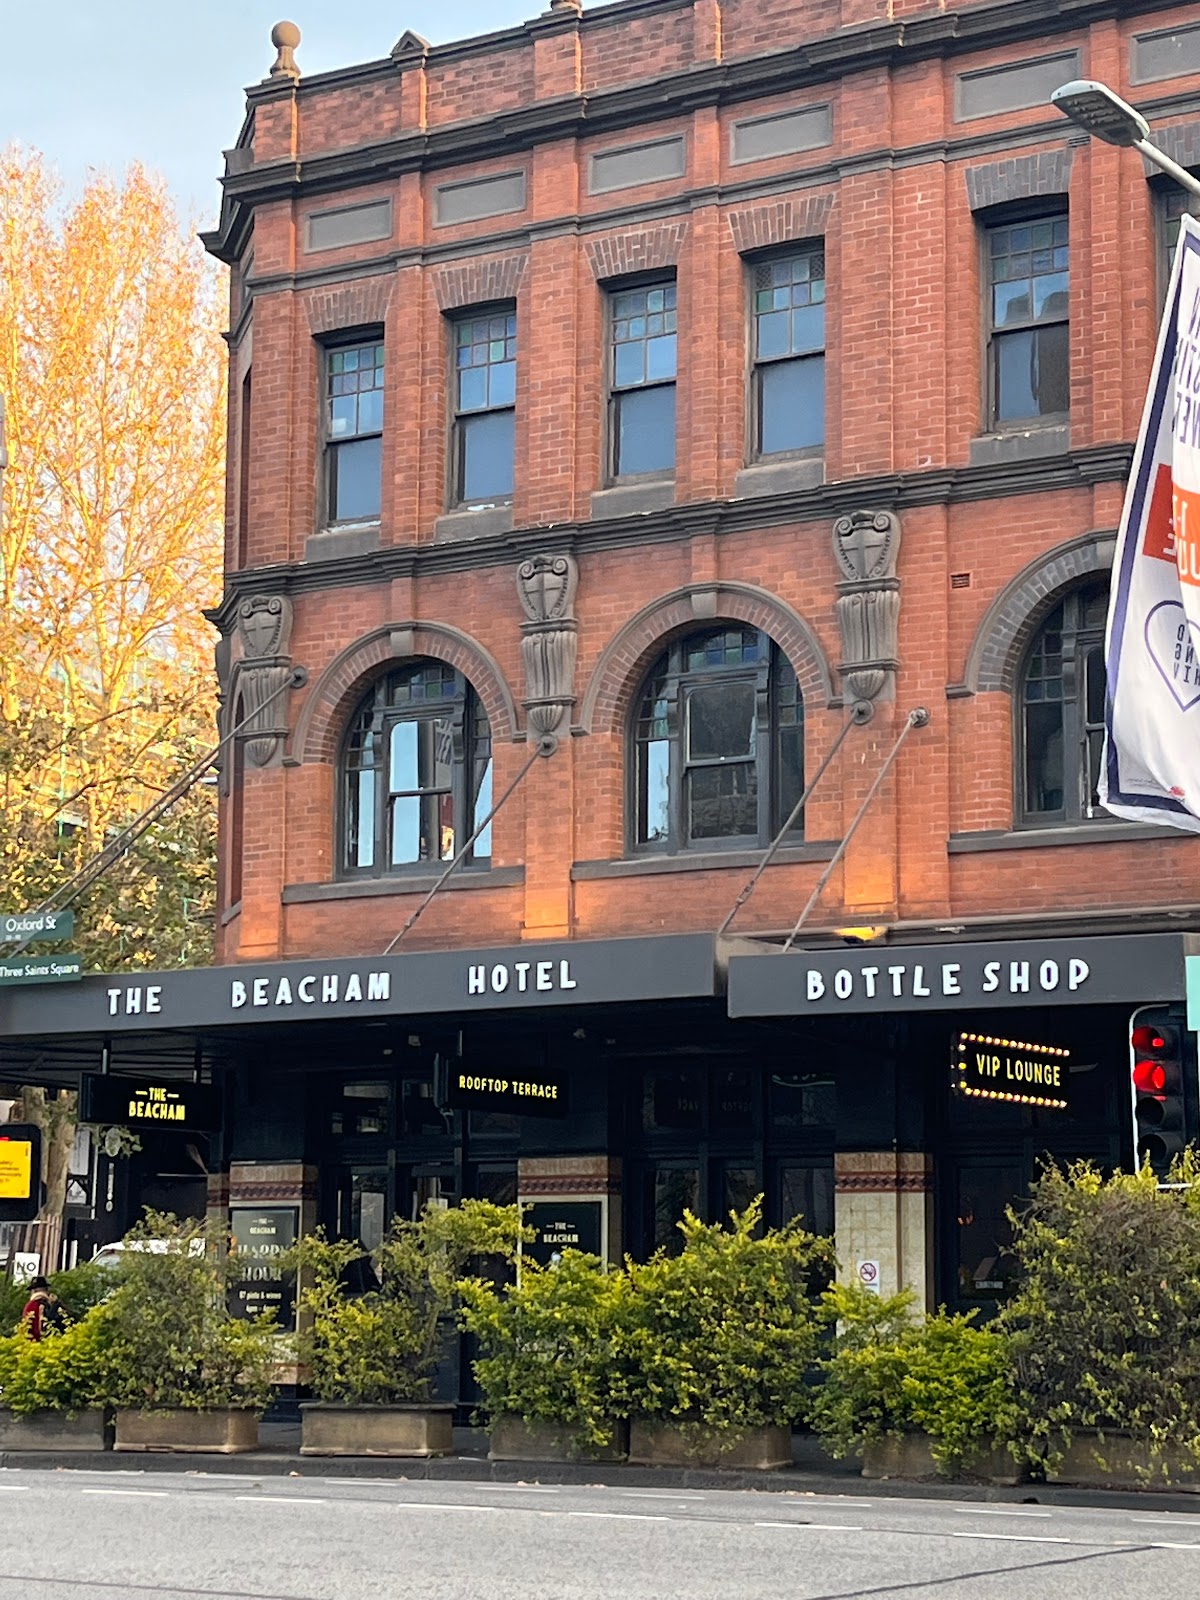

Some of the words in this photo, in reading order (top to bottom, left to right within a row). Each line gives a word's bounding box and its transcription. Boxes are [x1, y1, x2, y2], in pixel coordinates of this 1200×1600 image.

[5, 917, 44, 932] Oxford
[45, 915, 57, 930] St
[0, 965, 23, 977] Three
[25, 964, 49, 976] Saints
[50, 962, 79, 976] Square
[806, 963, 961, 1000] BOTTLE
[982, 958, 1089, 993] SHOP
[107, 986, 162, 1015] THE
[231, 972, 391, 1008] BEACHAM
[468, 960, 577, 995] HOTEL
[976, 1053, 1001, 1077] VIP
[1006, 1058, 1061, 1087] LOUNGE
[149, 1087, 167, 1102] THE
[459, 1075, 508, 1093] ROOFTOP
[512, 1081, 558, 1099] TERRACE
[129, 1100, 186, 1121] BEACHAM
[16, 1261, 36, 1272] NO
